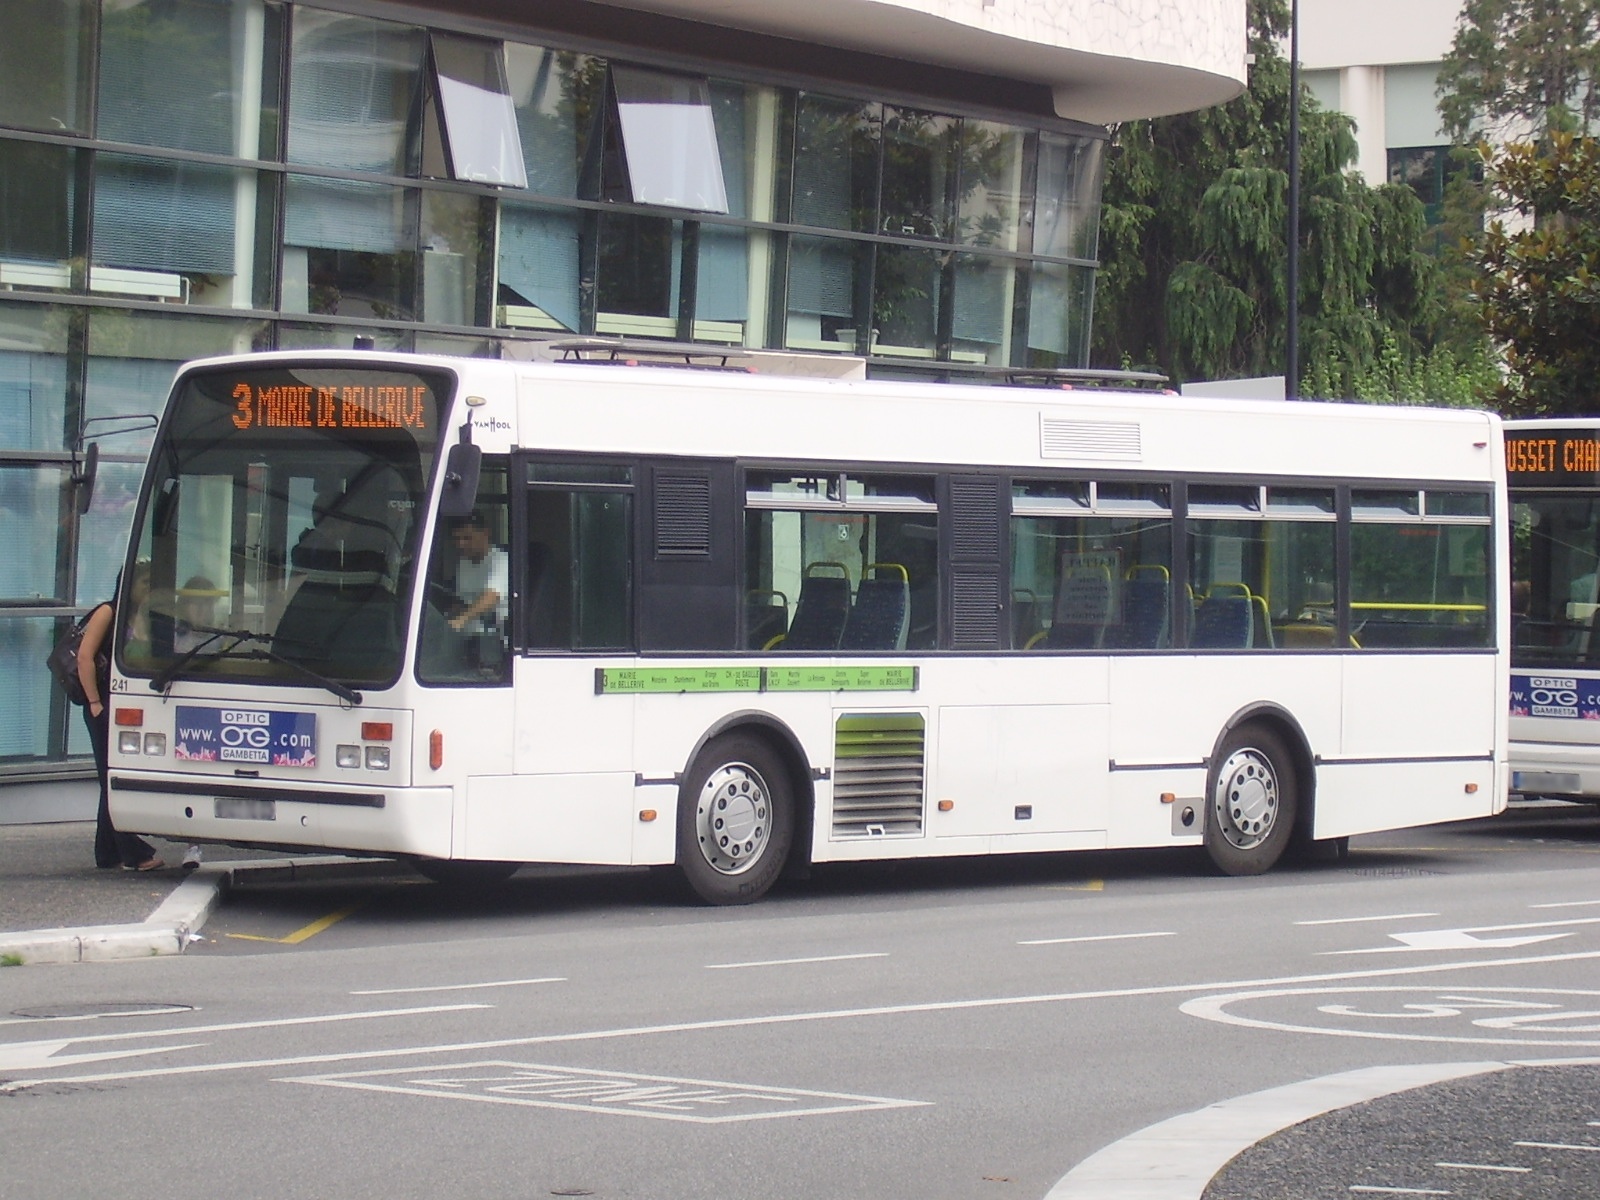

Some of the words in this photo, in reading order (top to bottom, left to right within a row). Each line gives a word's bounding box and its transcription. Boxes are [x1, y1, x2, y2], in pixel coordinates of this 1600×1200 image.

[232, 383, 253, 429] 3
[257, 386, 313, 427] MAIRIE
[317, 386, 337, 427] DE
[342, 386, 426, 428] BELLERIVE
[1504, 440, 1557, 471] USSET
[111, 679, 128, 692] 241
[1533, 679, 1574, 688] OPTIC
[1533, 706, 1577, 716] GAMBETTA
[224, 712, 266, 724] OPTIC
[179, 727, 217, 742] www.
[222, 749, 268, 761] GAMBETTA
